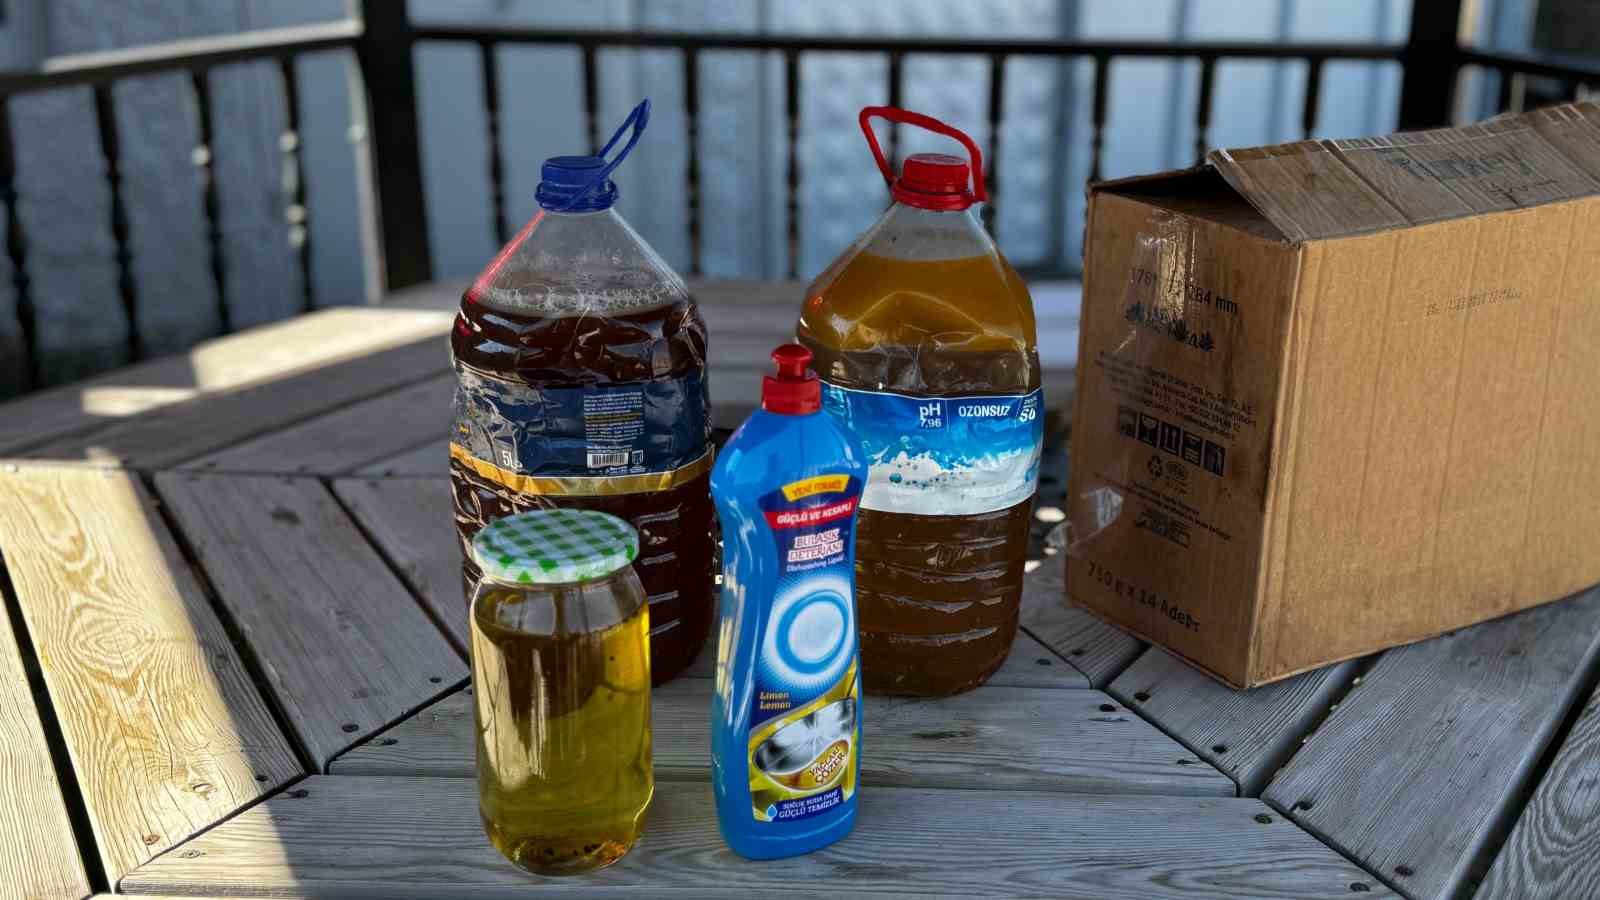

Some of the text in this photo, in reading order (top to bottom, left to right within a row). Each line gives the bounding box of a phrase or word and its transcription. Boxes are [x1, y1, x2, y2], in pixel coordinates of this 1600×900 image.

[1215, 295, 1237, 313] mm
[919, 402, 941, 419] pH
[958, 405, 1011, 418] OZONSUZ
[777, 513, 807, 525] GÜÇLÜ
[809, 511, 821, 521] VE
[760, 701, 791, 710] Lemon
[779, 806, 806, 819] GÜÇLÜ
